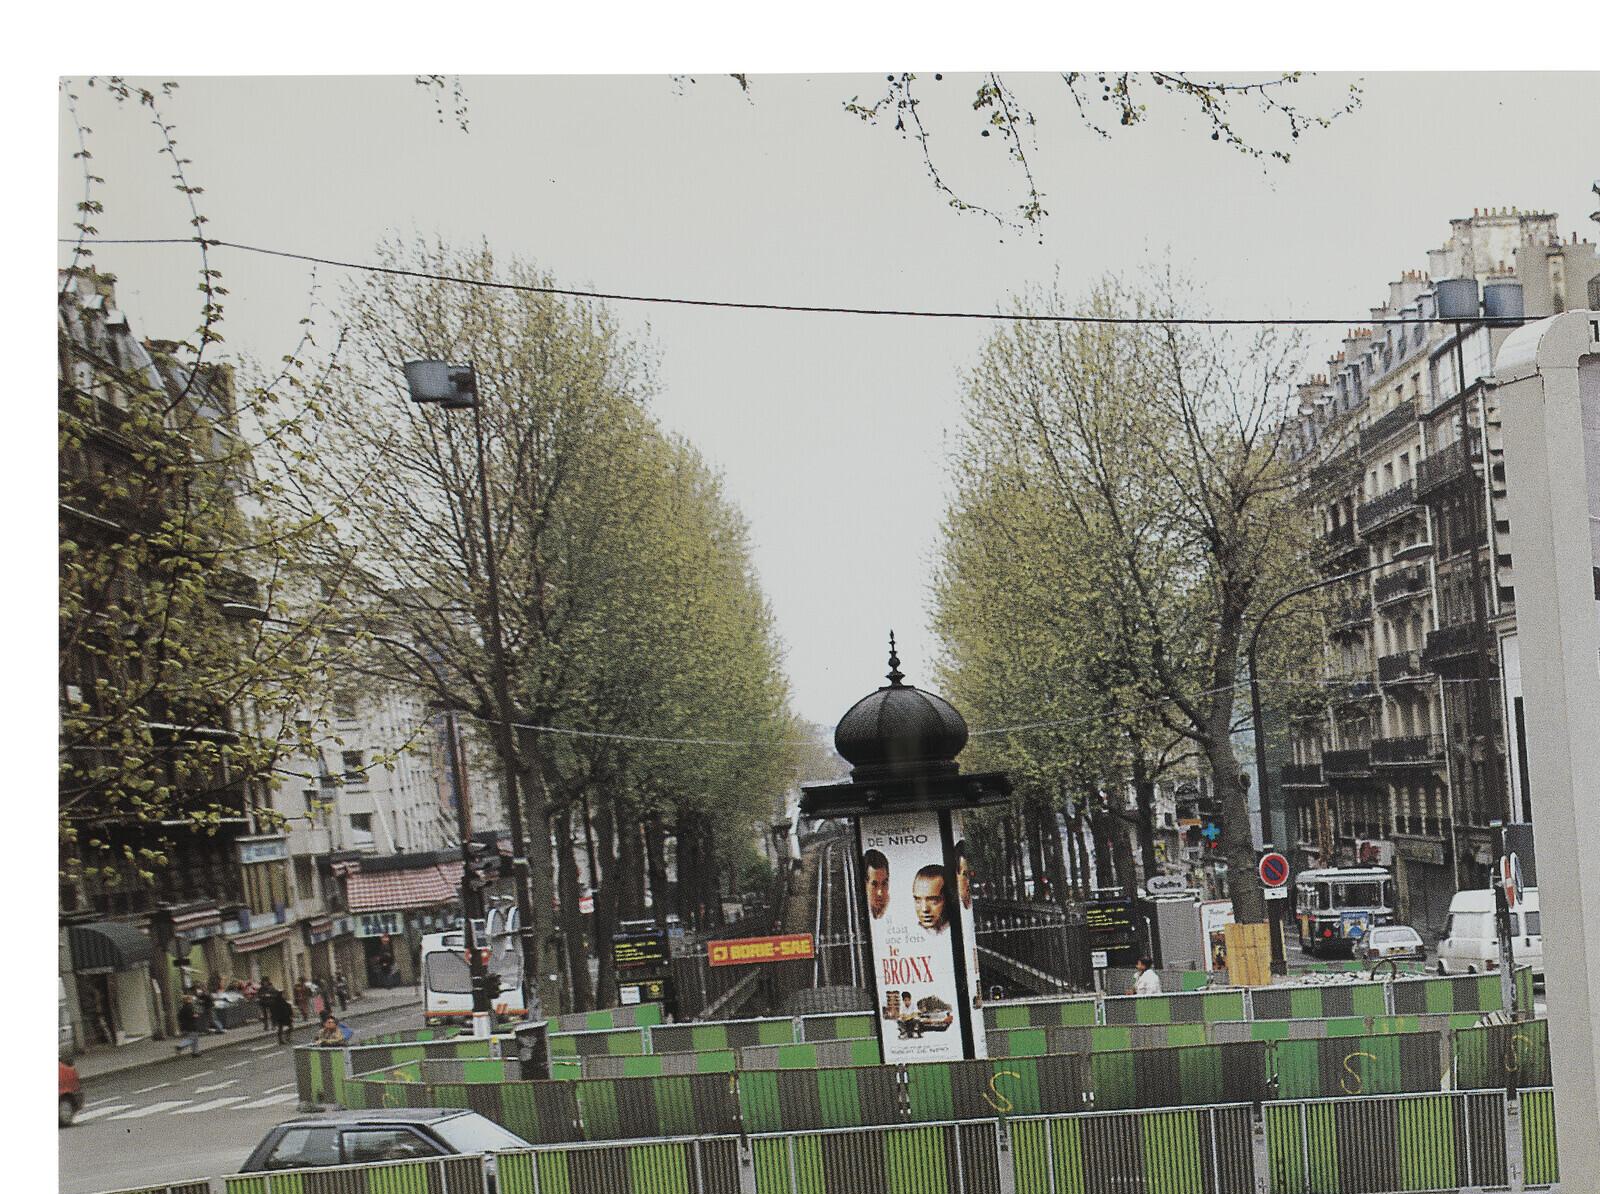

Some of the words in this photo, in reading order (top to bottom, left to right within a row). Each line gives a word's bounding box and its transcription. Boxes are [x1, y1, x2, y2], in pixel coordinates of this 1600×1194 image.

[868, 838, 884, 847] DE
[888, 834, 928, 846] NIRO
[889, 945, 900, 957] le
[882, 956, 934, 985] BRONX
